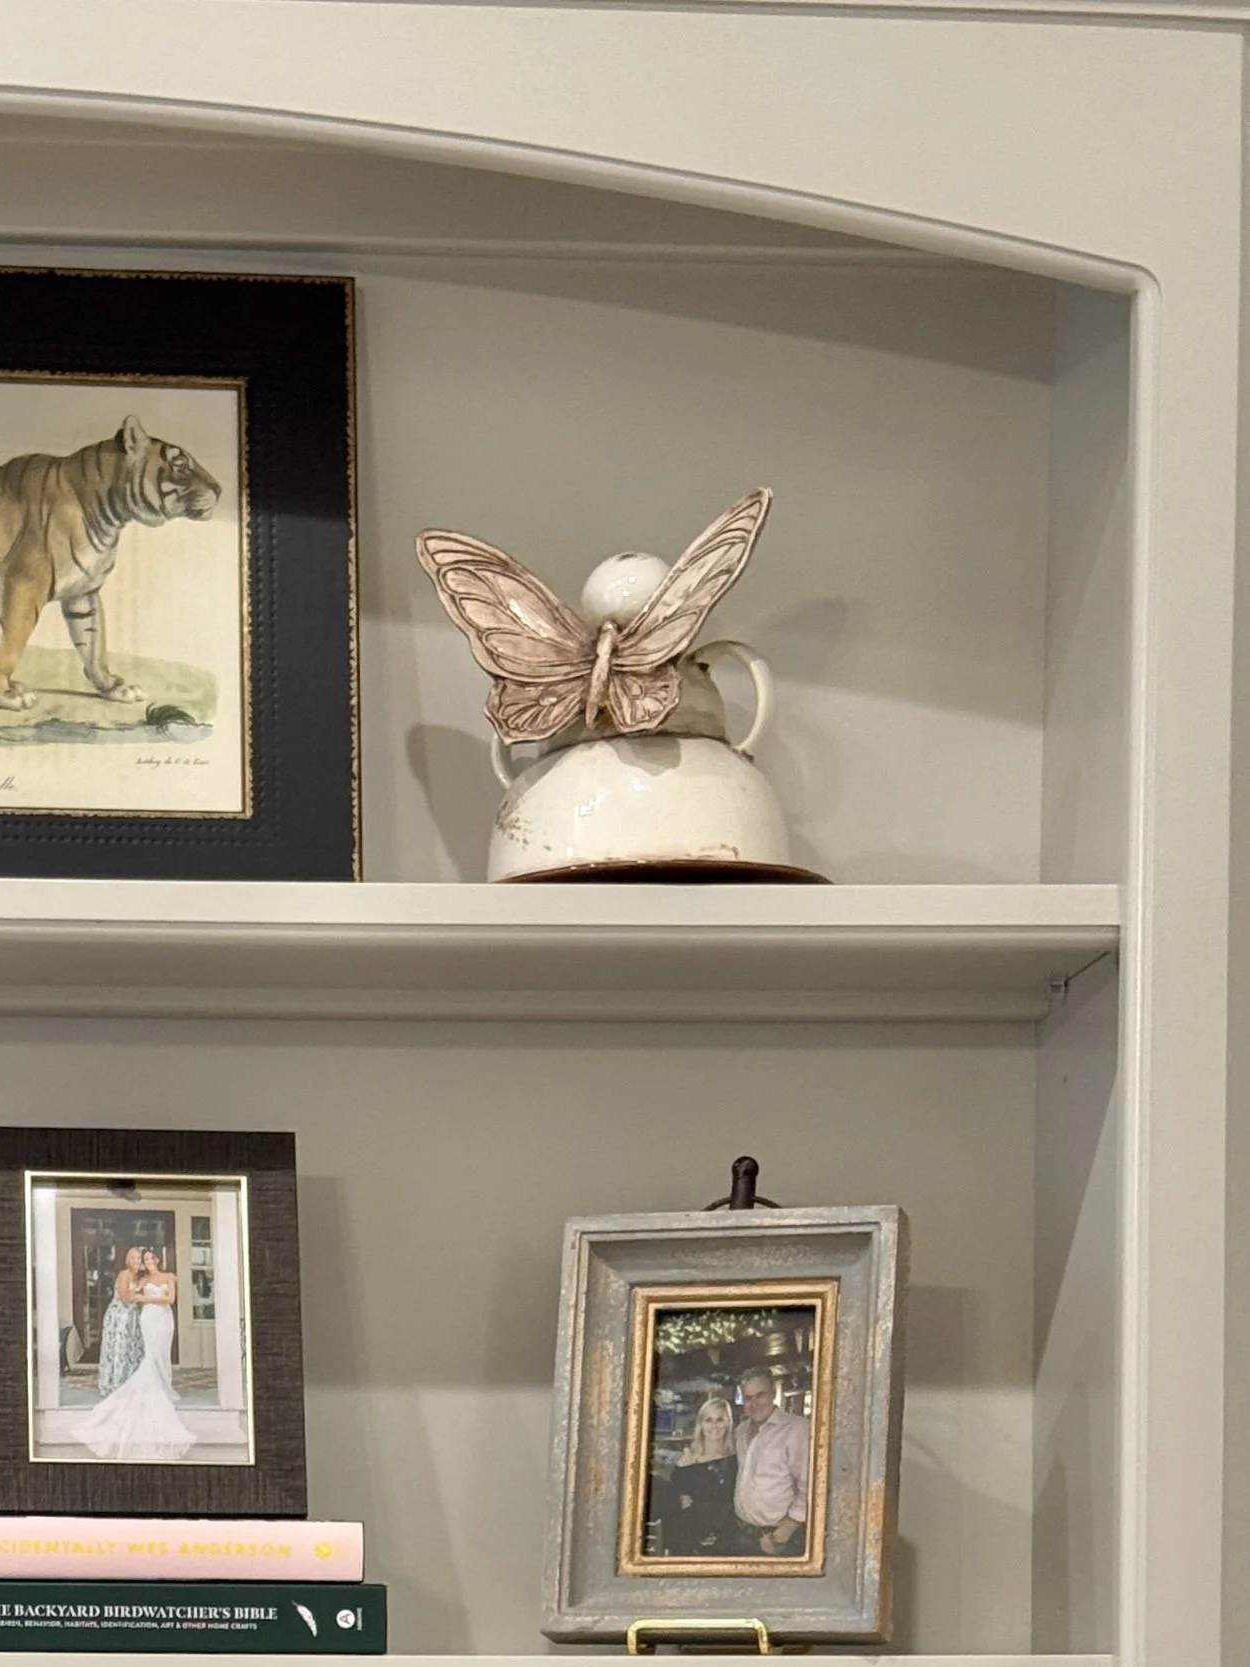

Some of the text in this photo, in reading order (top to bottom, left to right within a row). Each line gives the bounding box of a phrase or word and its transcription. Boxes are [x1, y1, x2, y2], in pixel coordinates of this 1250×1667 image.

[14, 1604, 100, 1617] BACKYARD
[103, 1605, 231, 1619] BIRDWATCHER'S
[234, 1607, 278, 1620] BIBLE
